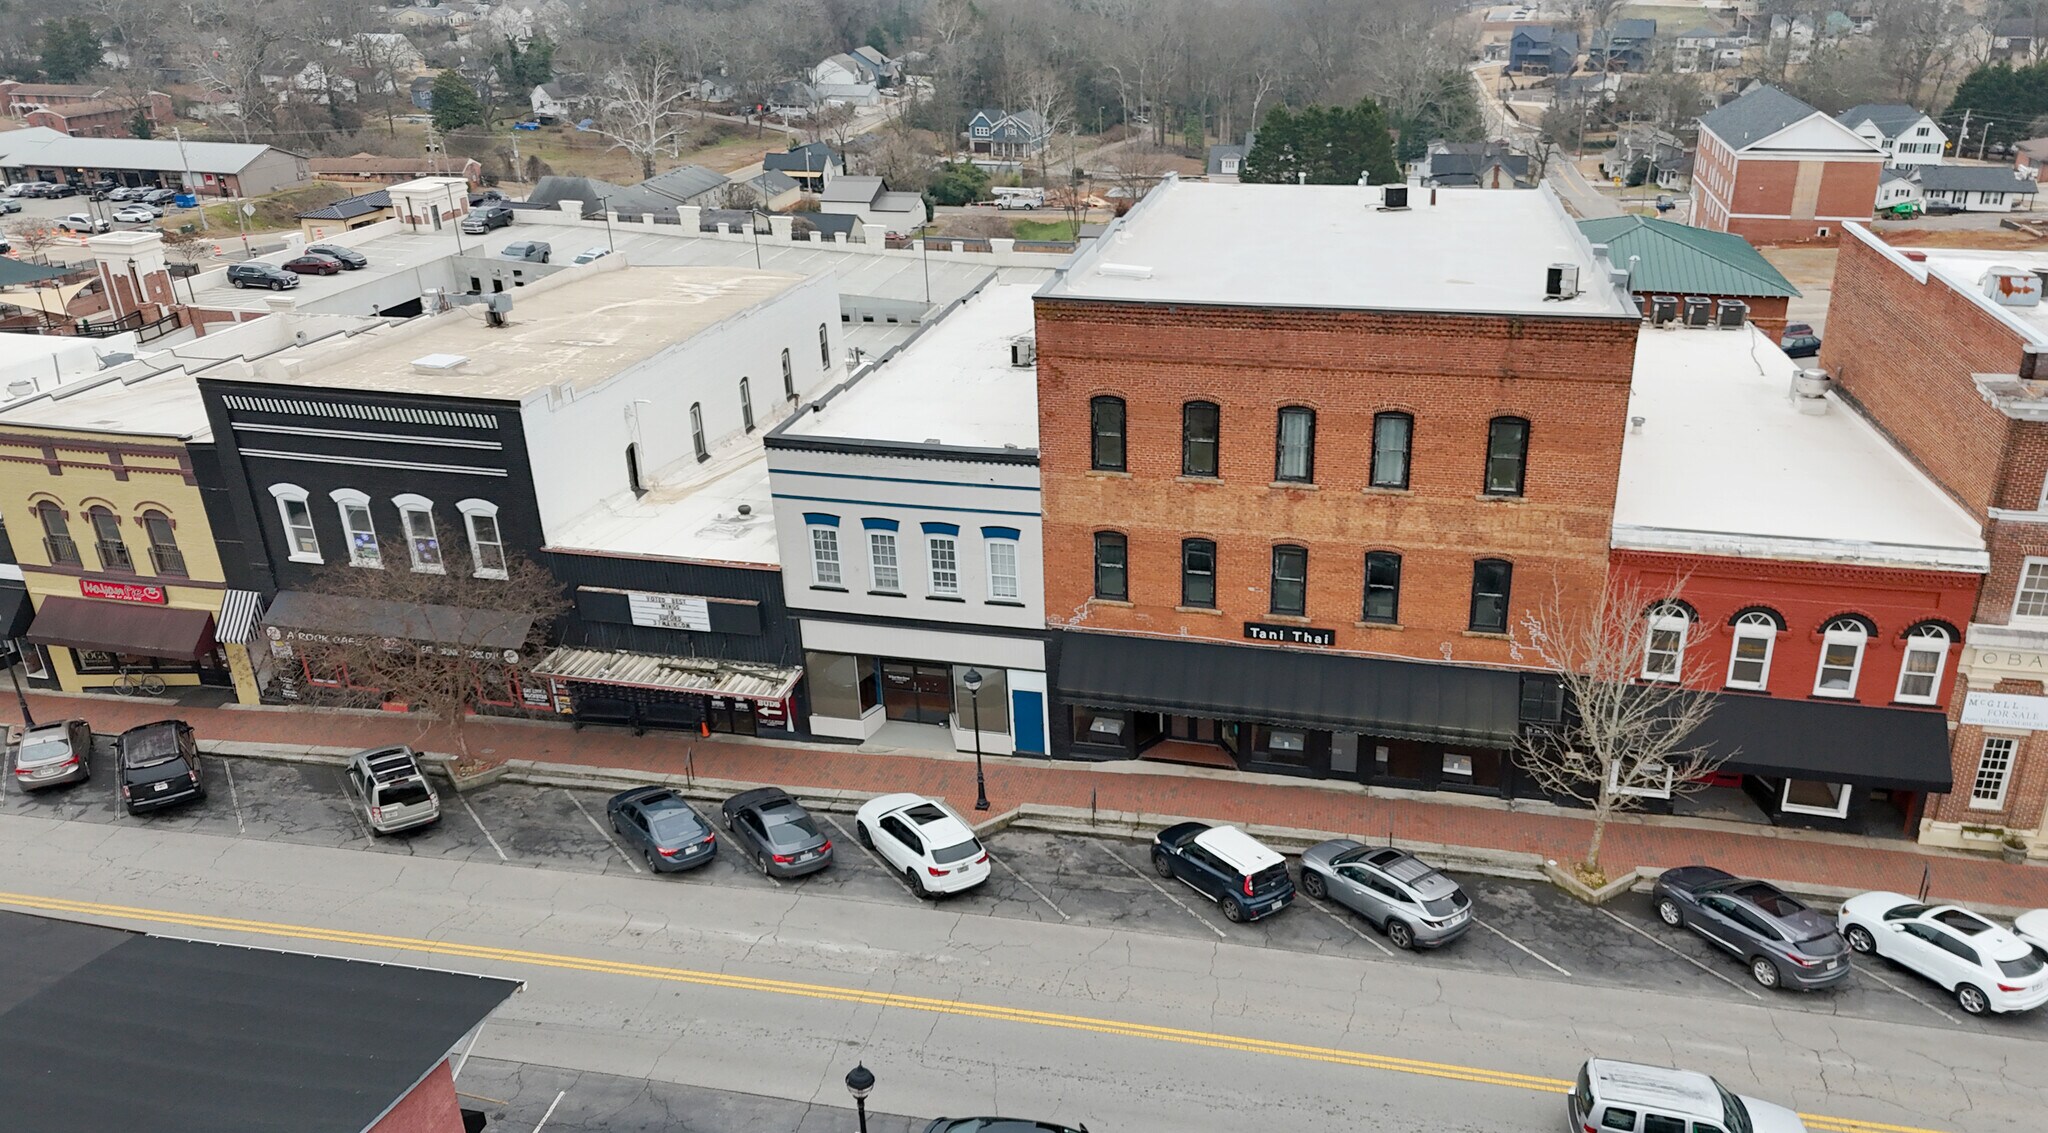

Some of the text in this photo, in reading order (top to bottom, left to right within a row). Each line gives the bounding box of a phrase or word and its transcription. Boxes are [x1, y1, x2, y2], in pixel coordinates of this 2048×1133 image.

[286, 631, 294, 640] A
[298, 632, 329, 643] ROCK
[1250, 627, 1328, 644] Tani Thai
[757, 700, 781, 708] BUDS
[1987, 709, 2039, 720] FOR SALE
